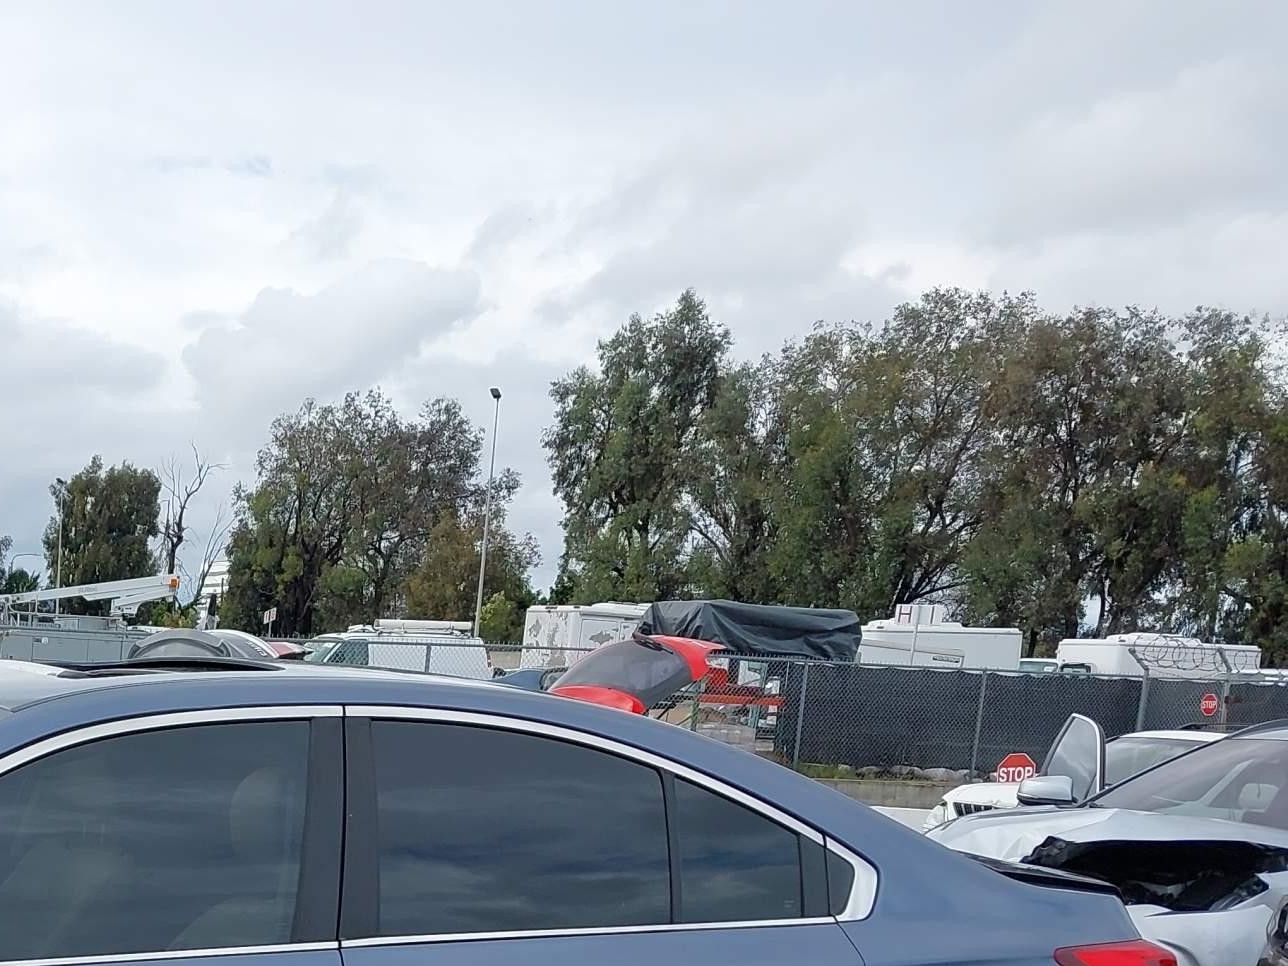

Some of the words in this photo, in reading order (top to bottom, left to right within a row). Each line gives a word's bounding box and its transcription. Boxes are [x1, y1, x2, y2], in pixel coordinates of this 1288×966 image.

[898, 605, 913, 623] H
[1202, 700, 1216, 709] STOP
[999, 766, 1033, 782] STOP
